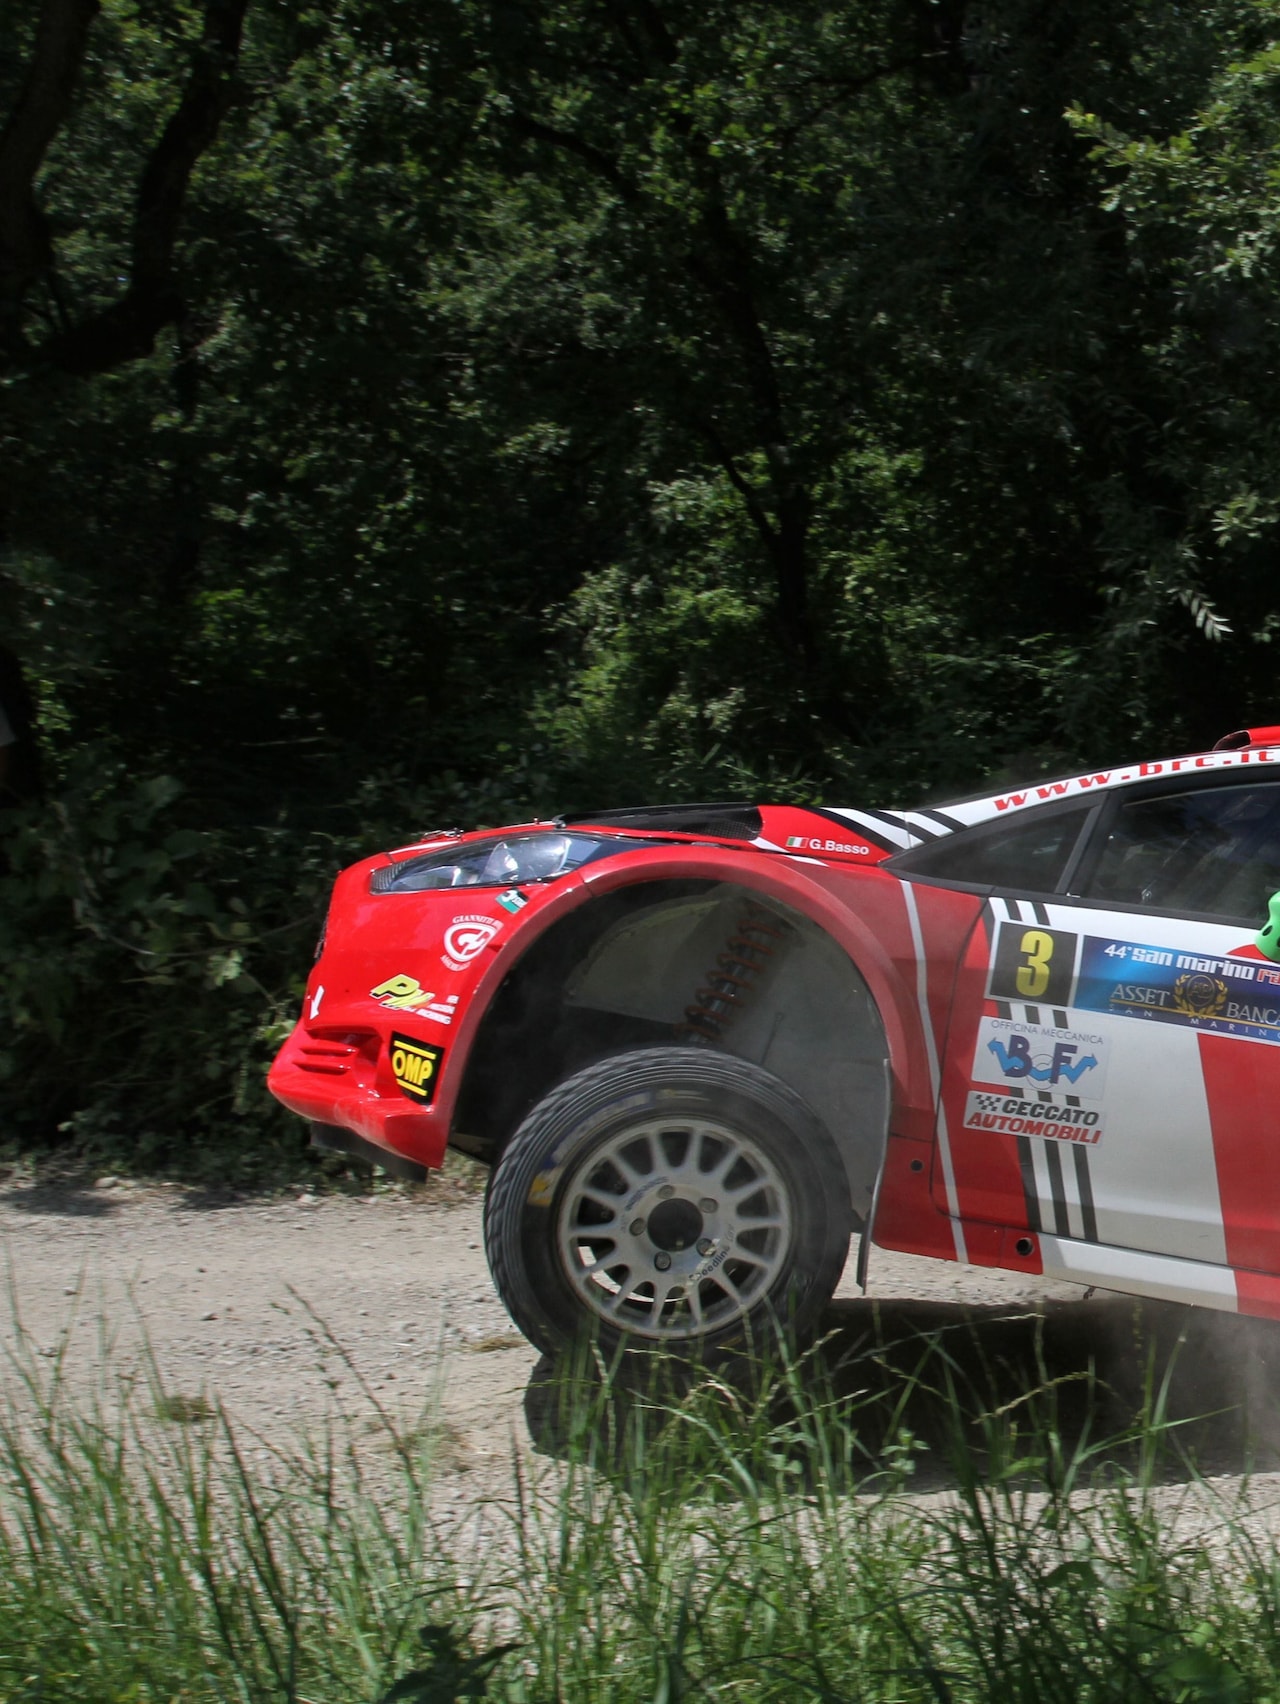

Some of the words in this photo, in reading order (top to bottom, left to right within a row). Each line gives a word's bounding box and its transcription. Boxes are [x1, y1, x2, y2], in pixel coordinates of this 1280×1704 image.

[994, 750, 1275, 811] www.brc.it
[809, 838, 870, 855] G.Basso
[1015, 930, 1054, 997] 3
[1176, 954, 1255, 981] marino
[1110, 983, 1171, 1006] ASSET
[991, 1019, 1038, 1034] OFFICINA
[1041, 1027, 1104, 1045] MECCANICA
[392, 1049, 433, 1086] OMP
[1002, 1099, 1099, 1126] CECCATO
[966, 1112, 1102, 1144] AUTOMOBILI
